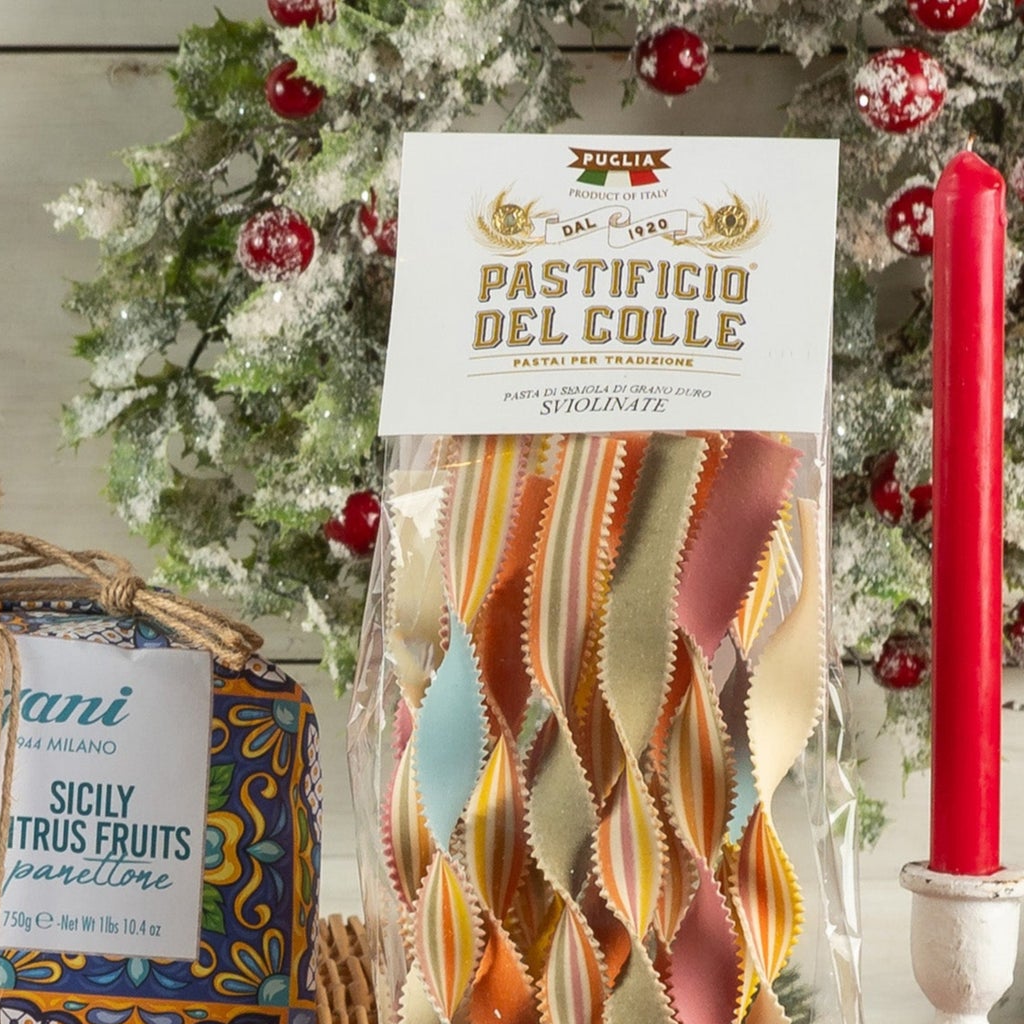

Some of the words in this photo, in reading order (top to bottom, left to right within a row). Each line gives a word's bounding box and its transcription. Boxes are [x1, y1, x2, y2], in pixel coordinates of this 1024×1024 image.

[582, 152, 655, 167] PUGLIA
[568, 188, 619, 201] PRODUCT
[623, 192, 636, 201] OF
[640, 188, 670, 200] ITALY
[562, 217, 597, 238] DAL
[628, 218, 669, 241] 1920
[477, 257, 752, 304] PASTIFICIO
[472, 305, 569, 350] DEL
[582, 305, 747, 350] COLLE
[513, 357, 566, 368] PASTAI
[571, 356, 598, 366] PER
[604, 354, 695, 367] TRADIZIONE
[503, 389, 540, 402] PASTA
[543, 388, 557, 398] DI
[560, 385, 610, 396] SEMOLA
[612, 384, 627, 394] DI
[629, 385, 673, 396] GRANO
[675, 387, 712, 399] DURO
[540, 396, 670, 416] SVIOLINATE
[16, 736, 42, 750] 944
[46, 737, 117, 756] MILANO
[50, 780, 135, 819] SICILY
[95, 821, 191, 861] FRUITS
[0, 849, 174, 897] panettone
[2, 910, 32, 932] 750g
[81, 916, 96, 932] Wt
[123, 918, 146, 936] 10.4
[149, 924, 162, 937] oz
